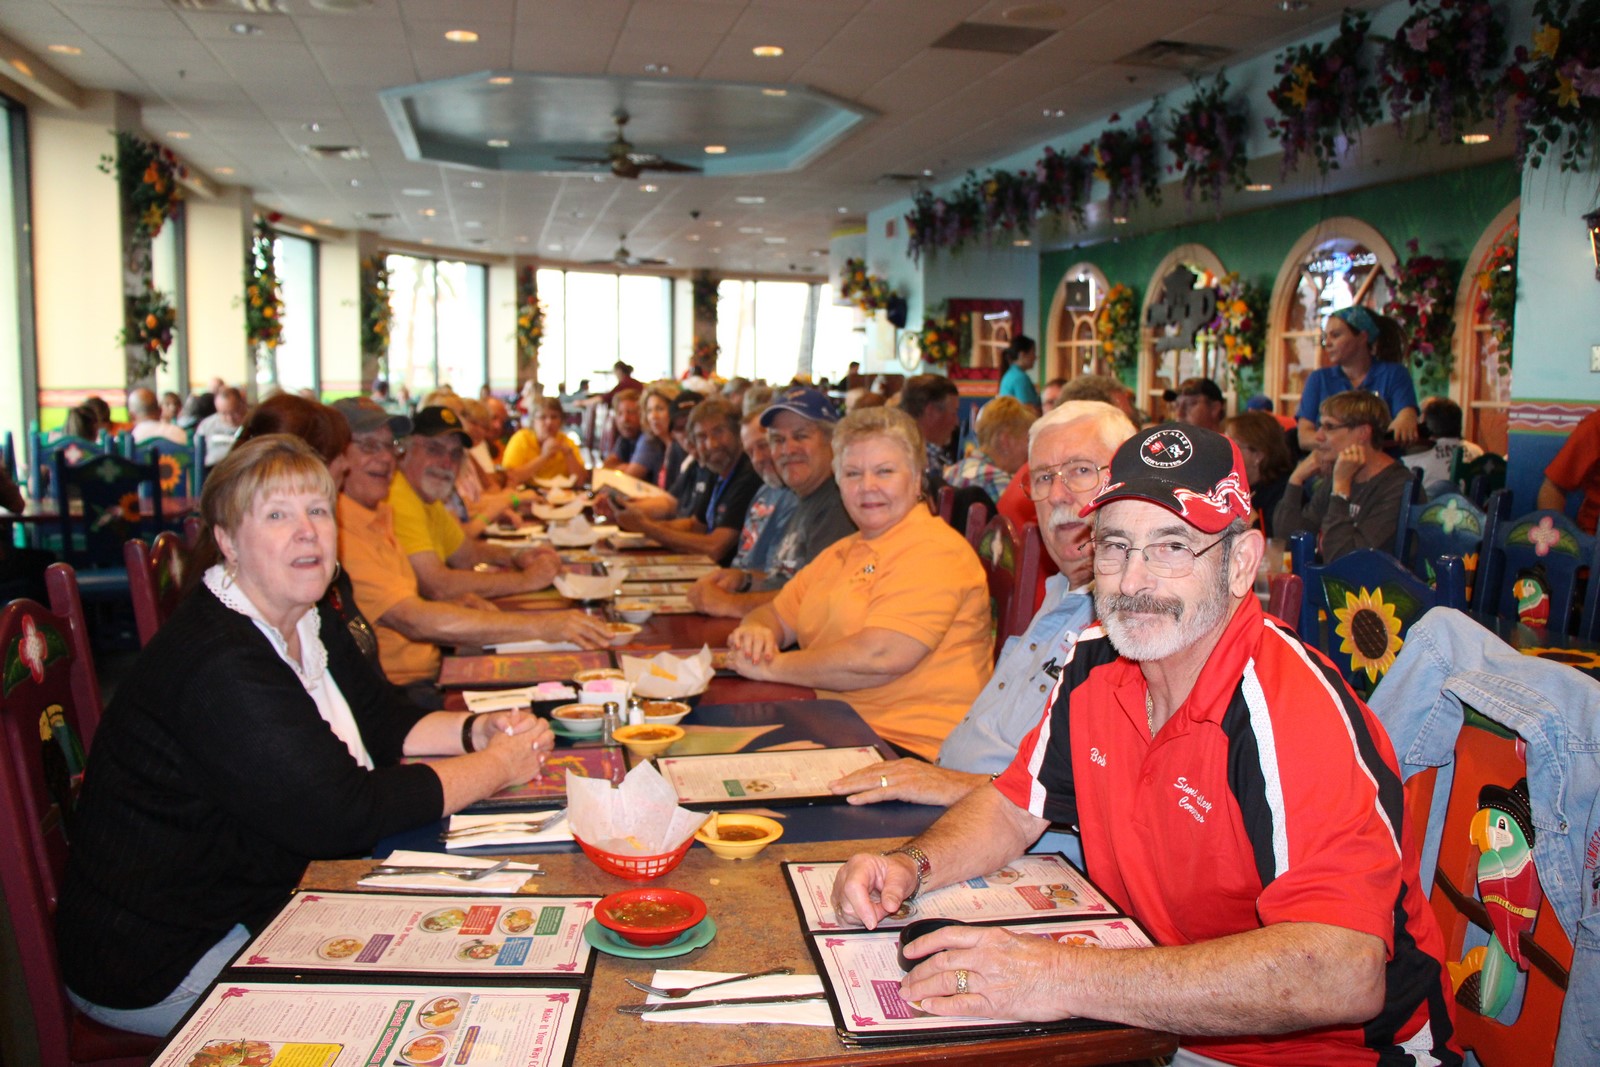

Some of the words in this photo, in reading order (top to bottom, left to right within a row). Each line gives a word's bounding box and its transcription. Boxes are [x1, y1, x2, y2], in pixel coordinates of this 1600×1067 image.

[1162, 431, 1190, 450] VALLEY
[1144, 456, 1182, 467] CORVETTES
[1090, 747, 1107, 767] Bob
[1173, 776, 1199, 798] Simi
[848, 969, 860, 988] Burritos
[541, 1007, 554, 1023] Make
[535, 1031, 547, 1045] Your
[529, 1046, 543, 1059] Way
